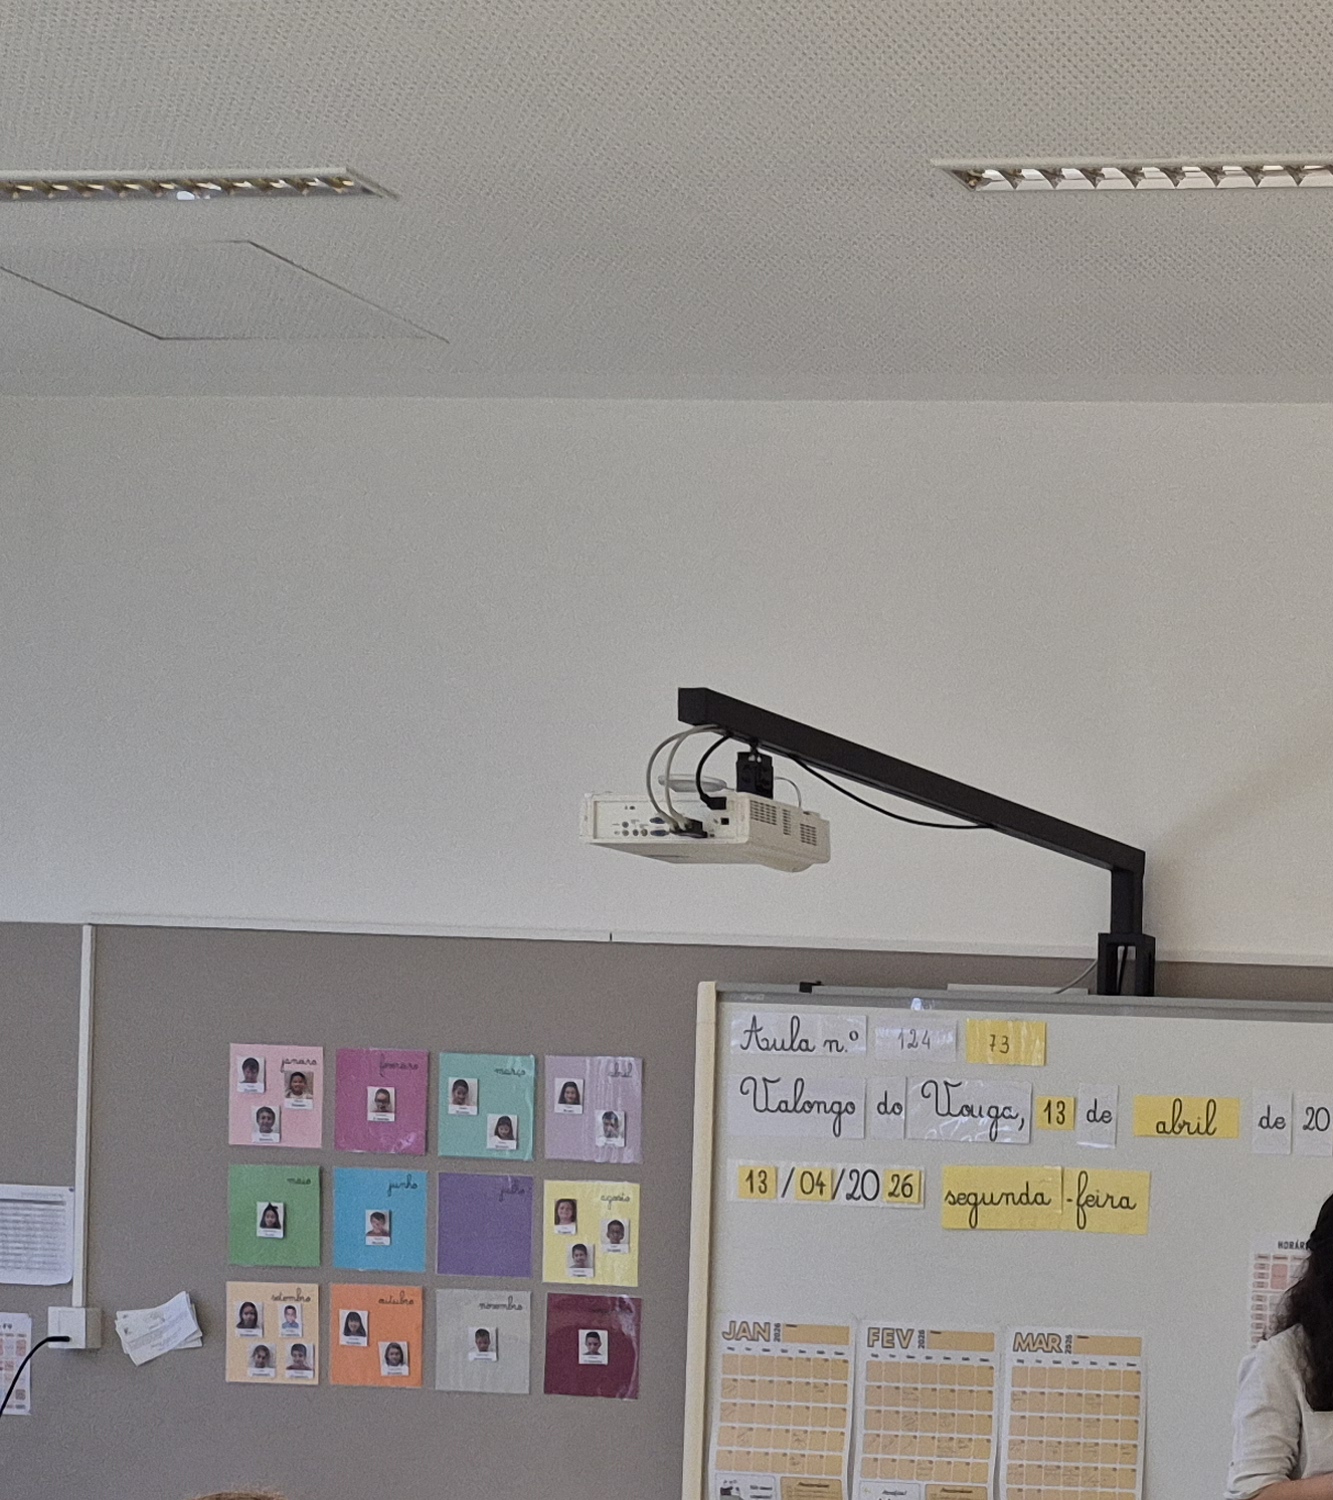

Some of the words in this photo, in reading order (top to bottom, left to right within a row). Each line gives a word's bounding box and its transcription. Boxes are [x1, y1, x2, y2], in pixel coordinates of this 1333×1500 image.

[740, 1014, 816, 1052] Aula
[897, 1027, 931, 1051] 124
[988, 1034, 1010, 1054] 73
[739, 1076, 857, 1138] Valongo
[876, 1090, 904, 1116] do
[920, 1080, 1025, 1142] Vouga,
[1042, 1099, 1067, 1126] 13
[1085, 1098, 1114, 1124] de
[1155, 1098, 1218, 1136] abril
[1257, 1104, 1287, 1130] de
[387, 1174, 418, 1197] junho
[722, 1320, 771, 1342] JAN
[867, 1326, 915, 1349] FEV
[1012, 1332, 1064, 1354] MAR
